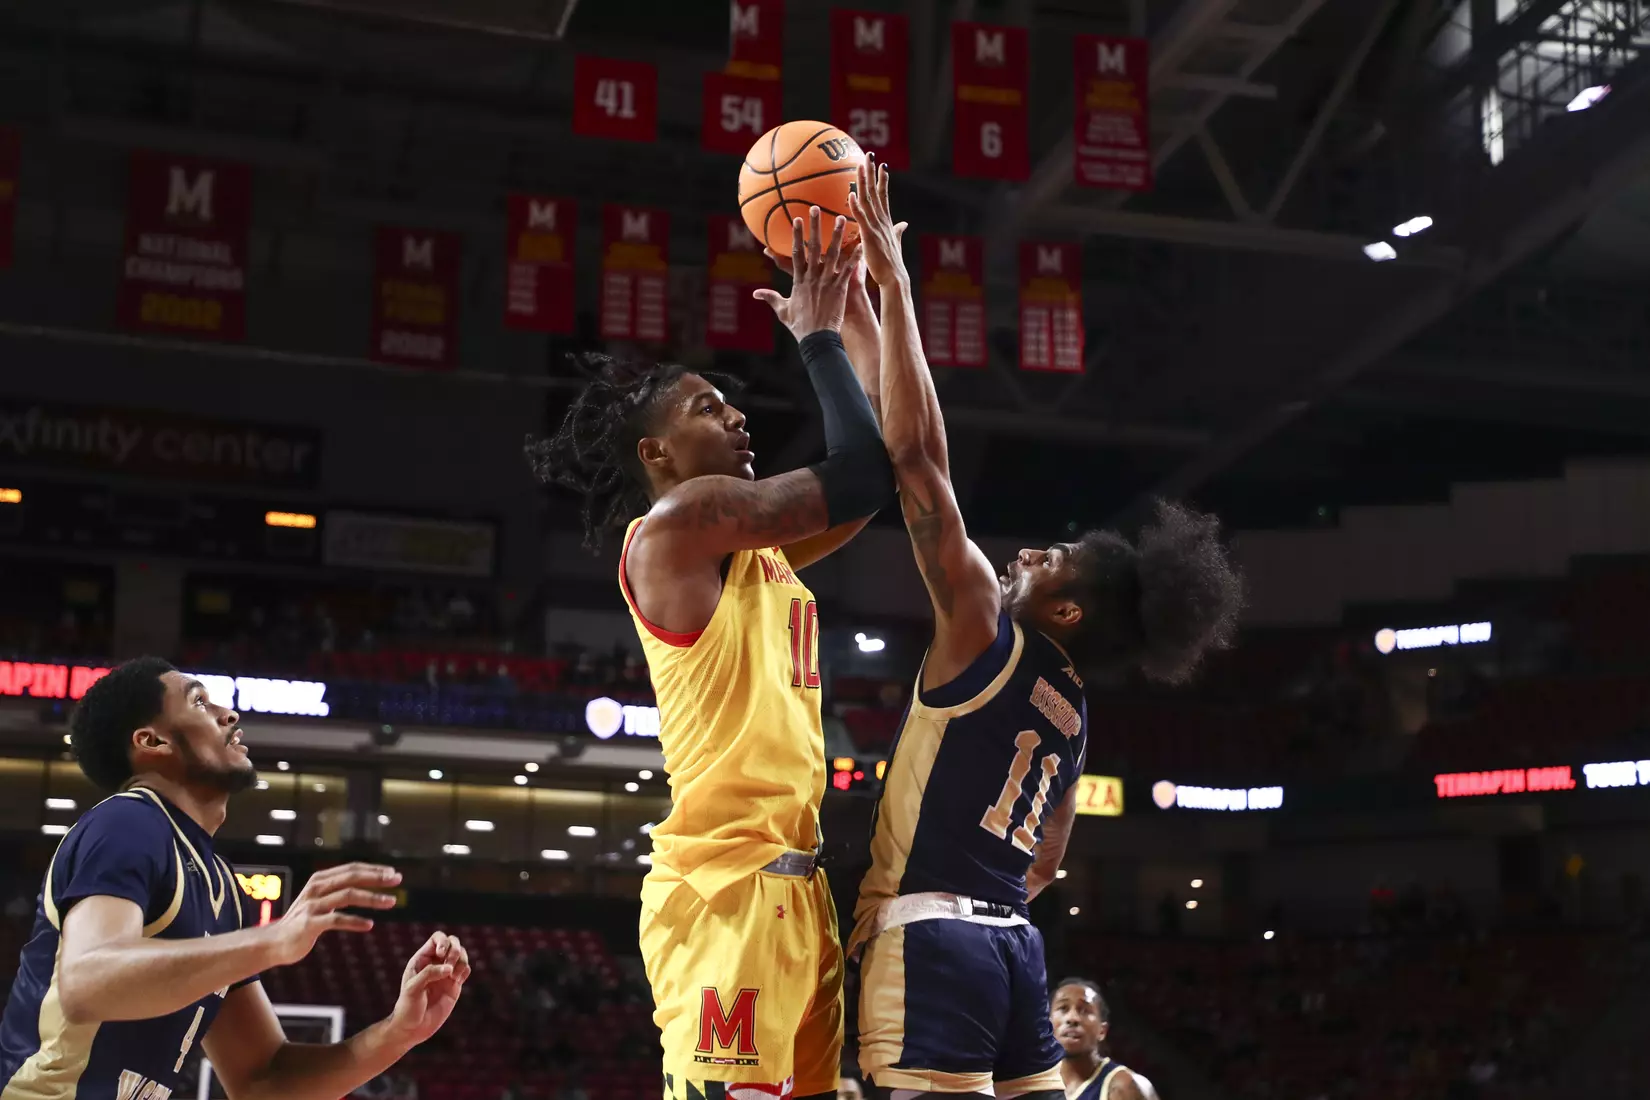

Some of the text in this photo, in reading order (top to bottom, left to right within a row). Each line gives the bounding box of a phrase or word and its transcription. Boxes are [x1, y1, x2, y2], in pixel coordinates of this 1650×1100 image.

[853, 17, 885, 51] M
[974, 29, 1006, 63] M
[1096, 44, 1127, 74] M
[593, 78, 636, 120] 41
[719, 94, 765, 136] 54
[848, 108, 890, 149] 25
[979, 121, 1004, 158] 6
[165, 166, 217, 222] M
[528, 199, 557, 231] M
[621, 209, 650, 241] M
[402, 235, 435, 272] M
[938, 240, 966, 269] M
[1036, 246, 1063, 274] M
[153, 428, 313, 474] center
[788, 598, 821, 689] 10
[1029, 675, 1083, 740] BISHOP
[979, 729, 1061, 857] 11
[1076, 782, 1121, 809] ZA
[694, 986, 761, 1056] M
